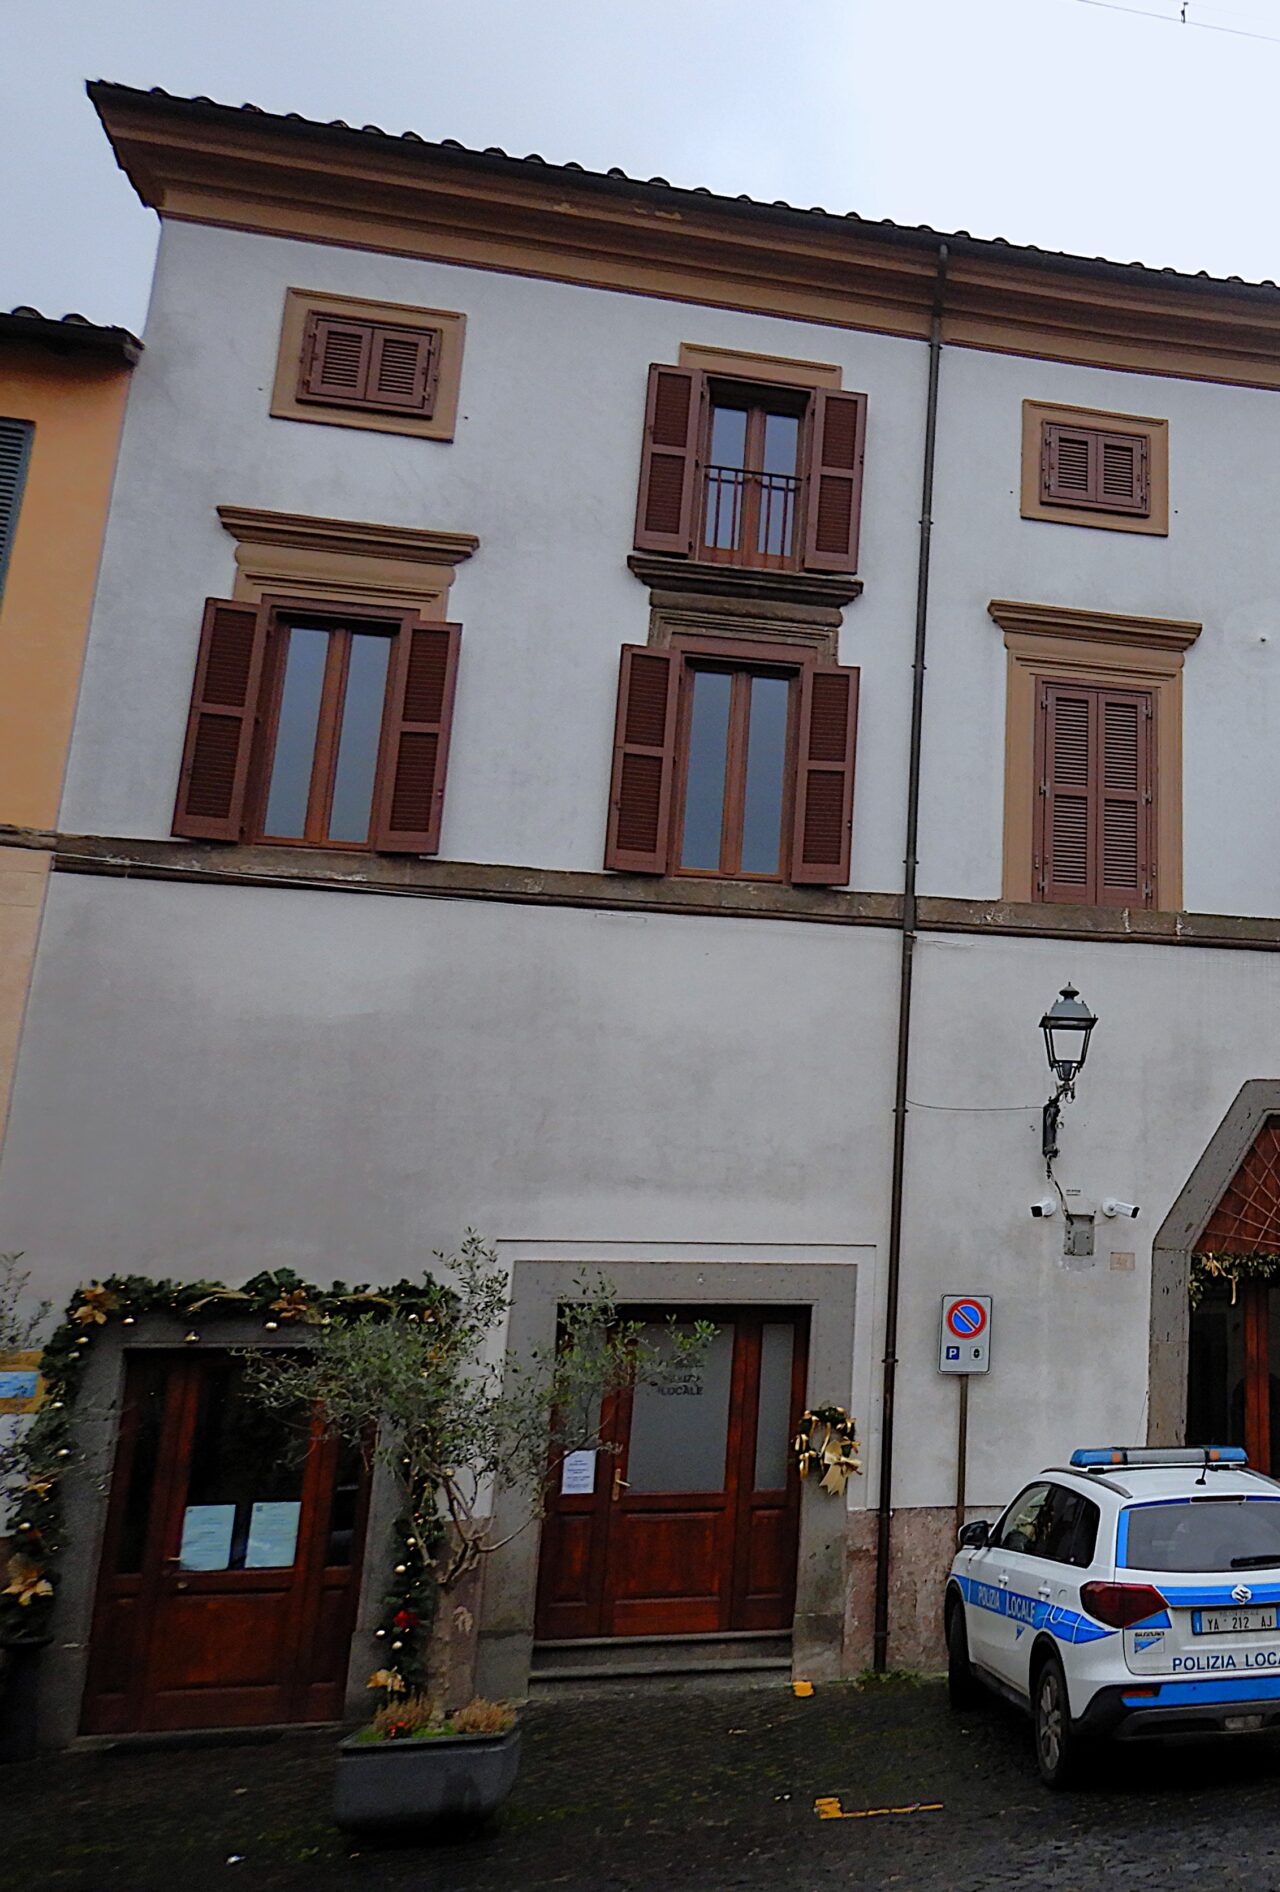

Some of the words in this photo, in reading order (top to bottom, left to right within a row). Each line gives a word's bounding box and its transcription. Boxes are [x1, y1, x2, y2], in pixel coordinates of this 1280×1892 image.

[948, 1348, 957, 1358] P
[978, 1585, 1001, 1611] POLIZIA
[1006, 1593, 1036, 1623] LOCALE
[1207, 1618, 1220, 1631] YA
[1232, 1616, 1250, 1630] 212
[1261, 1615, 1272, 1628] AJ
[1172, 1656, 1236, 1672] POLIZIA
